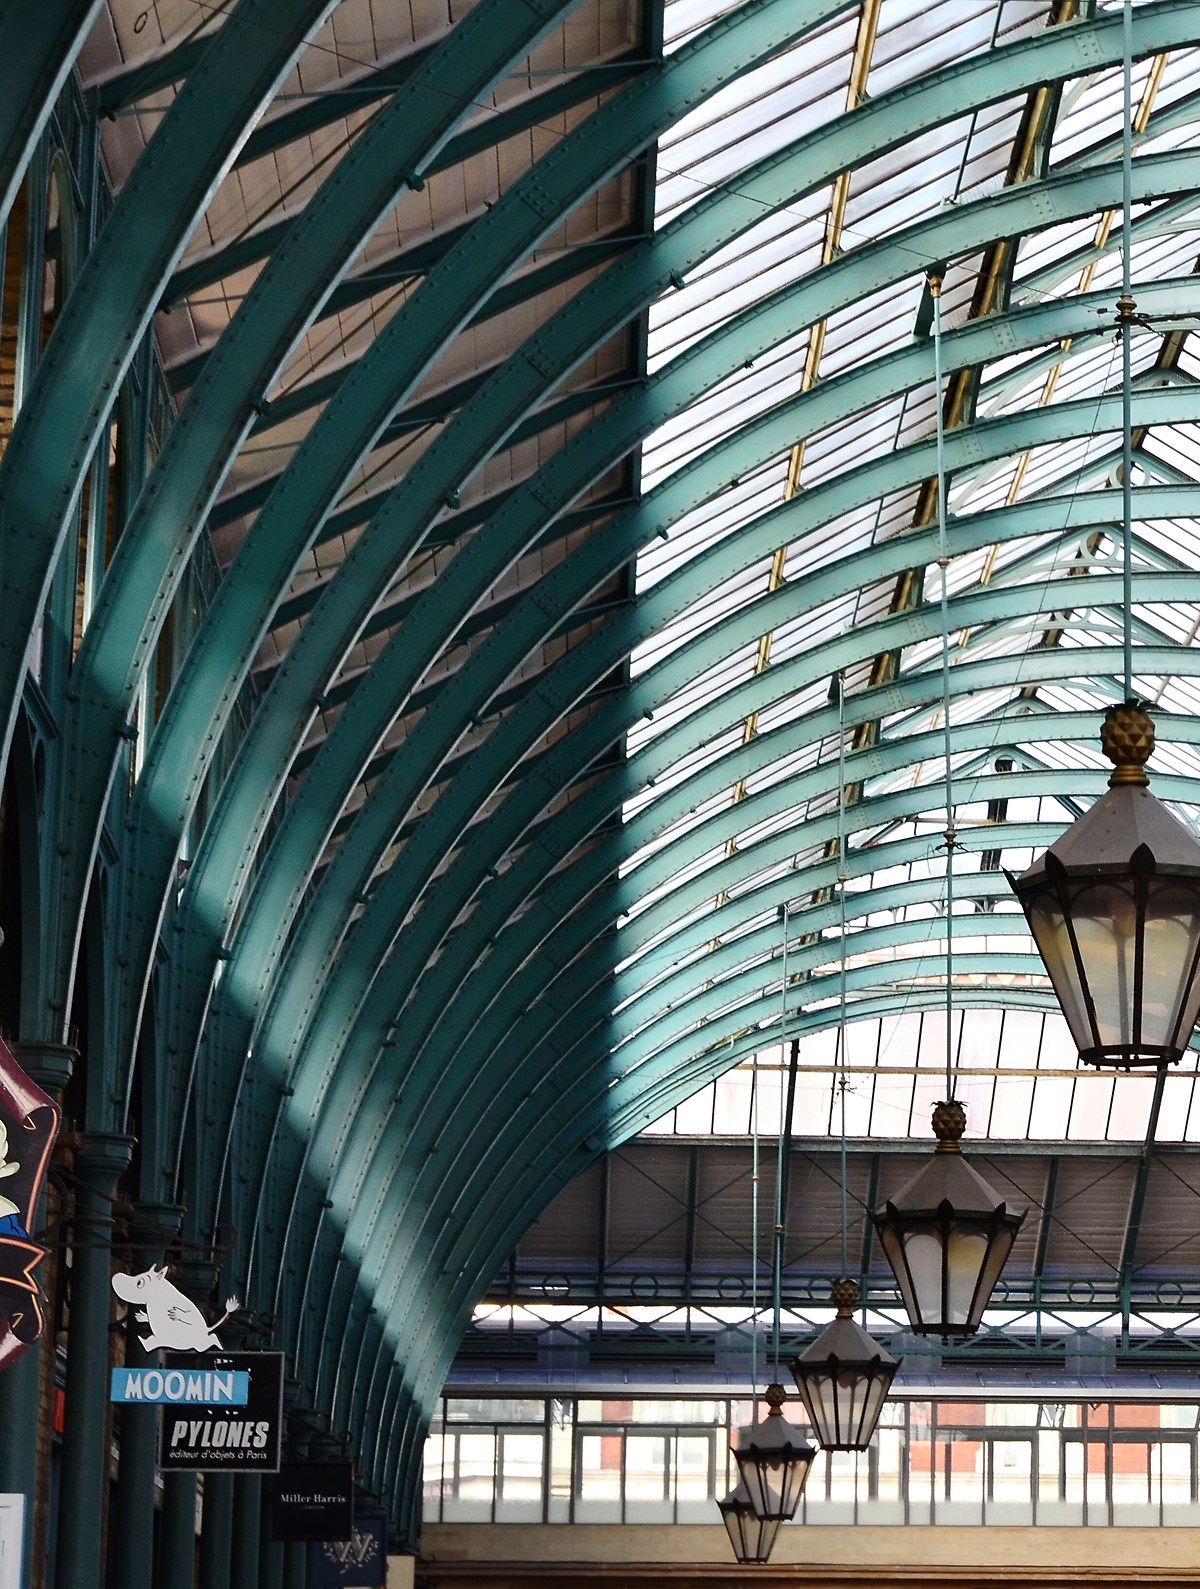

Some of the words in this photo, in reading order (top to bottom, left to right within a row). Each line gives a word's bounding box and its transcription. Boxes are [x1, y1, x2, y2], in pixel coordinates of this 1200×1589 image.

[124, 1371, 233, 1401] MOOMIN
[171, 1420, 270, 1449] PYLONES
[169, 1449, 199, 1459] éditeur
[201, 1450, 235, 1460] d'objets
[238, 1451, 244, 1459] à
[247, 1450, 267, 1459] Paris
[281, 1494, 312, 1503] Miller
[314, 1494, 346, 1503] Harris
